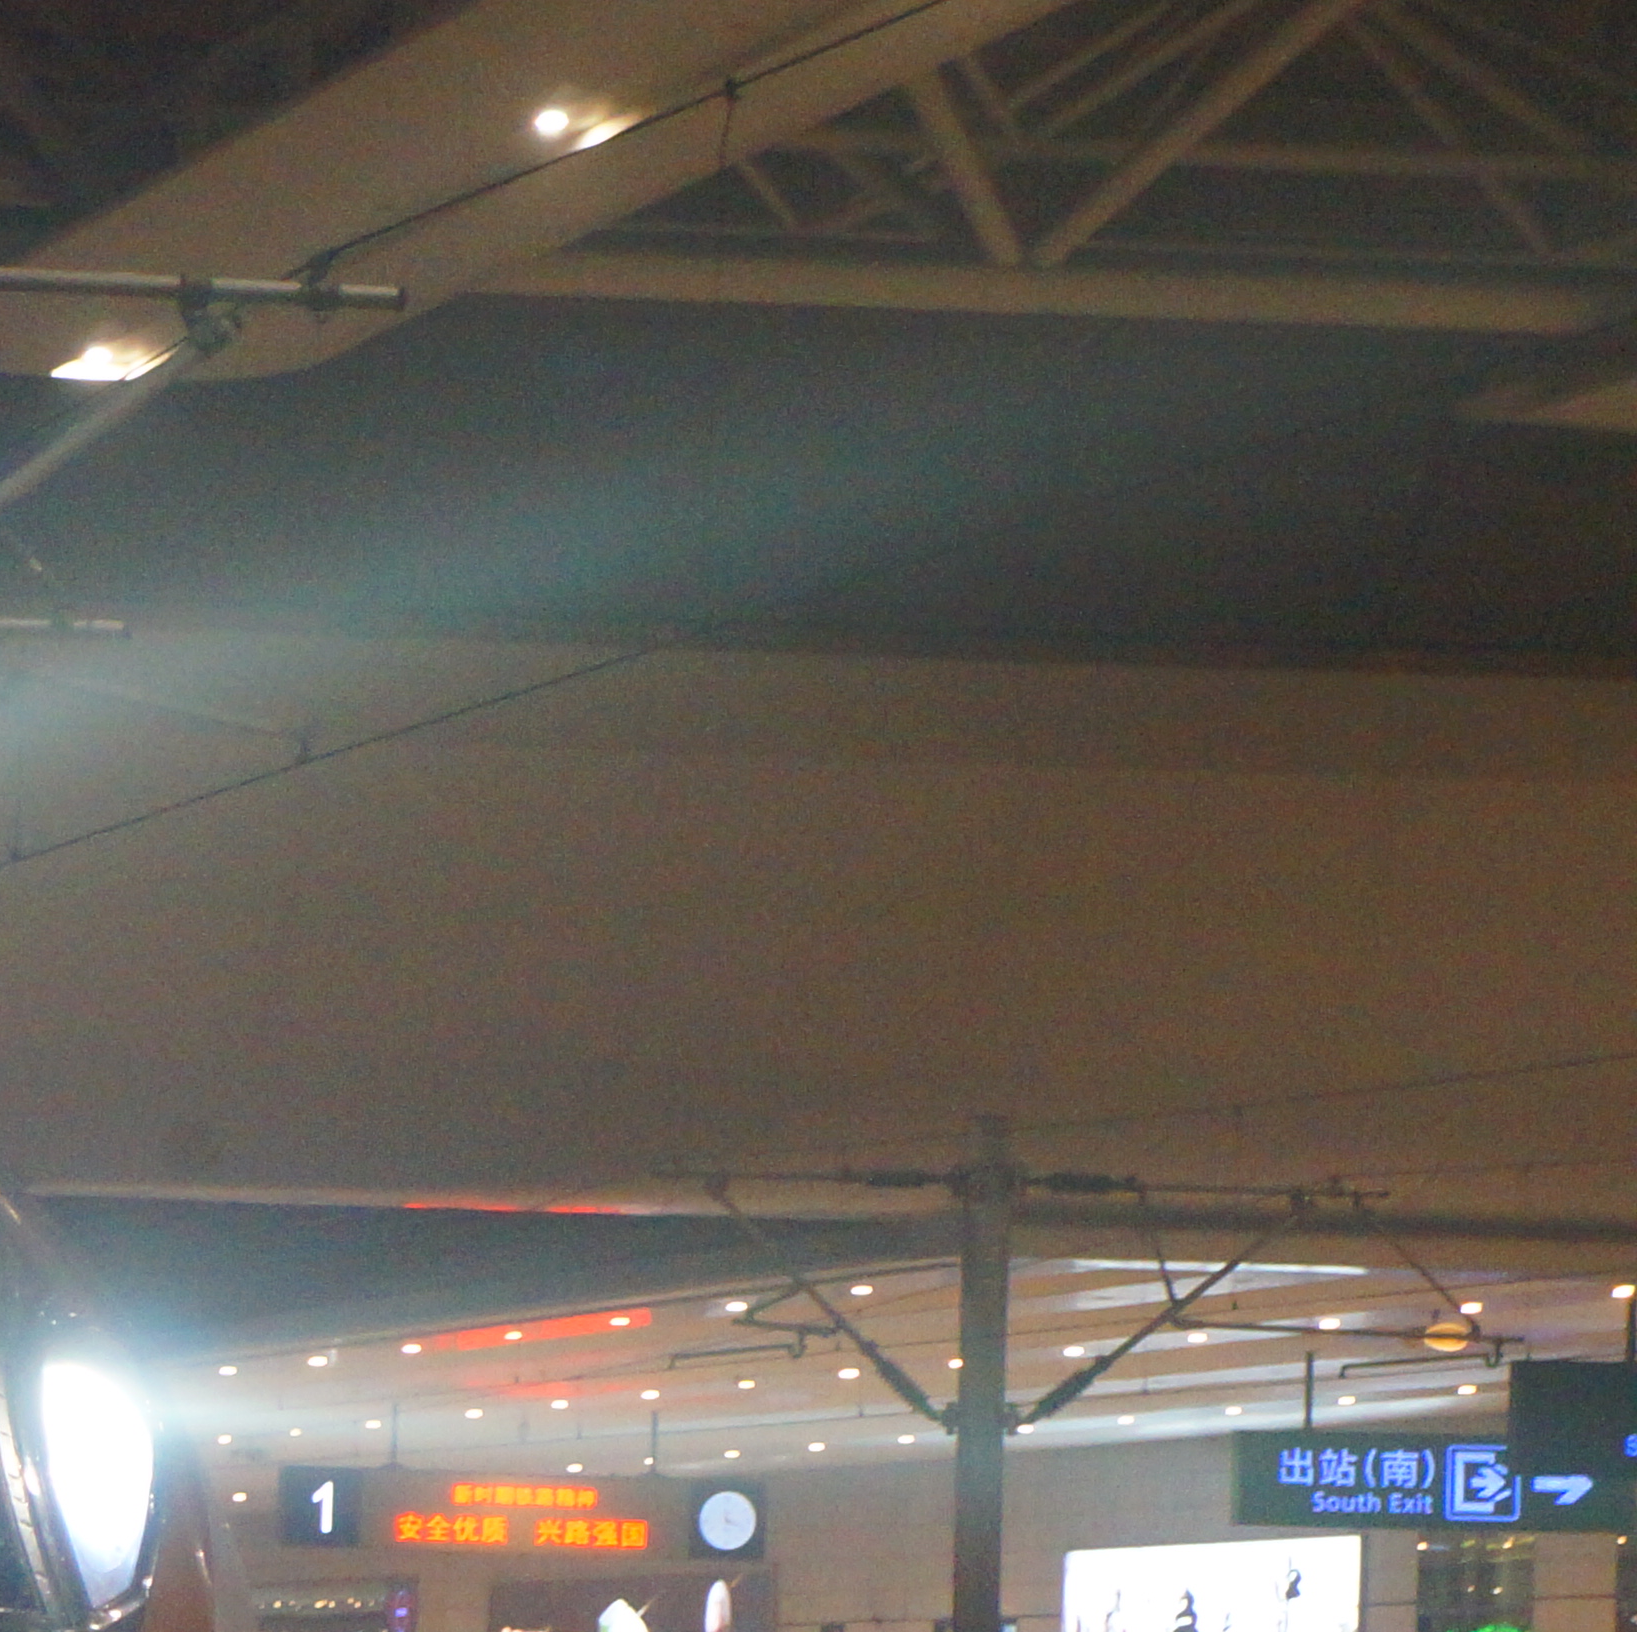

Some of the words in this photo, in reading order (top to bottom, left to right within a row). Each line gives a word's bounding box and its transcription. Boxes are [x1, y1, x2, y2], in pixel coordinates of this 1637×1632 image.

[311, 1480, 335, 1534] 1
[1311, 1490, 1381, 1514] South
[1388, 1492, 1434, 1515] Exit
[395, 1511, 509, 1544] 安全优质
[533, 1518, 648, 1549] 兴路强国
